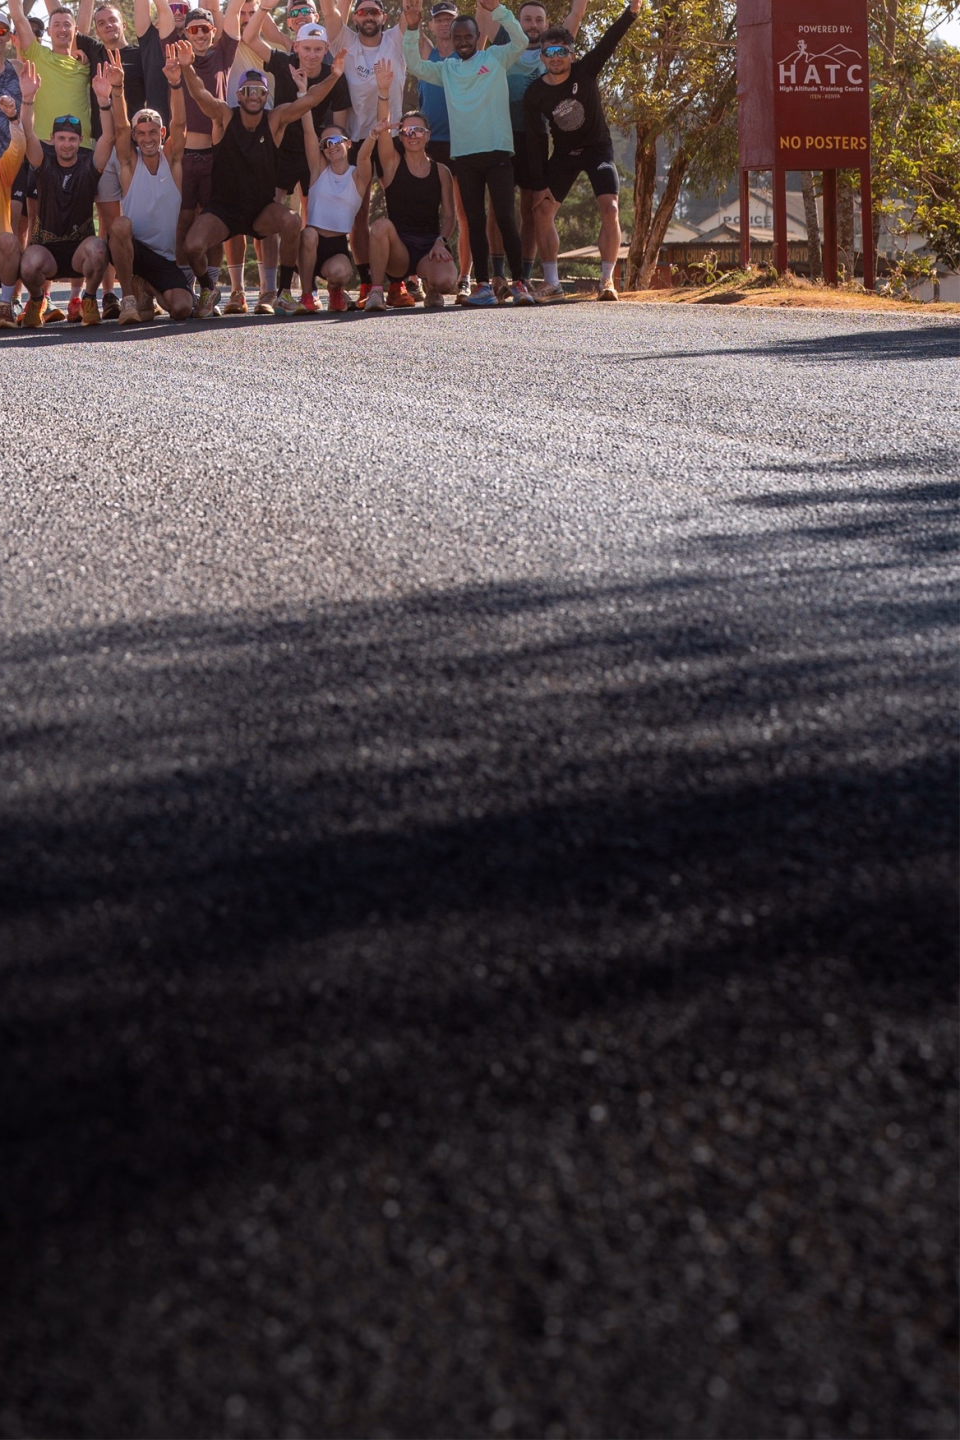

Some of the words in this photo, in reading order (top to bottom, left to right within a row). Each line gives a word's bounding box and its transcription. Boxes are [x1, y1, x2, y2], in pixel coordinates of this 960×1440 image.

[798, 25, 838, 33] POWERED
[840, 25, 853, 33] BY:
[779, 64, 863, 85] HATC
[779, 85, 794, 93] High
[819, 85, 844, 93] Training
[780, 135, 801, 150] NO
[805, 135, 867, 150] POSTERS
[723, 215, 772, 225] POICE
